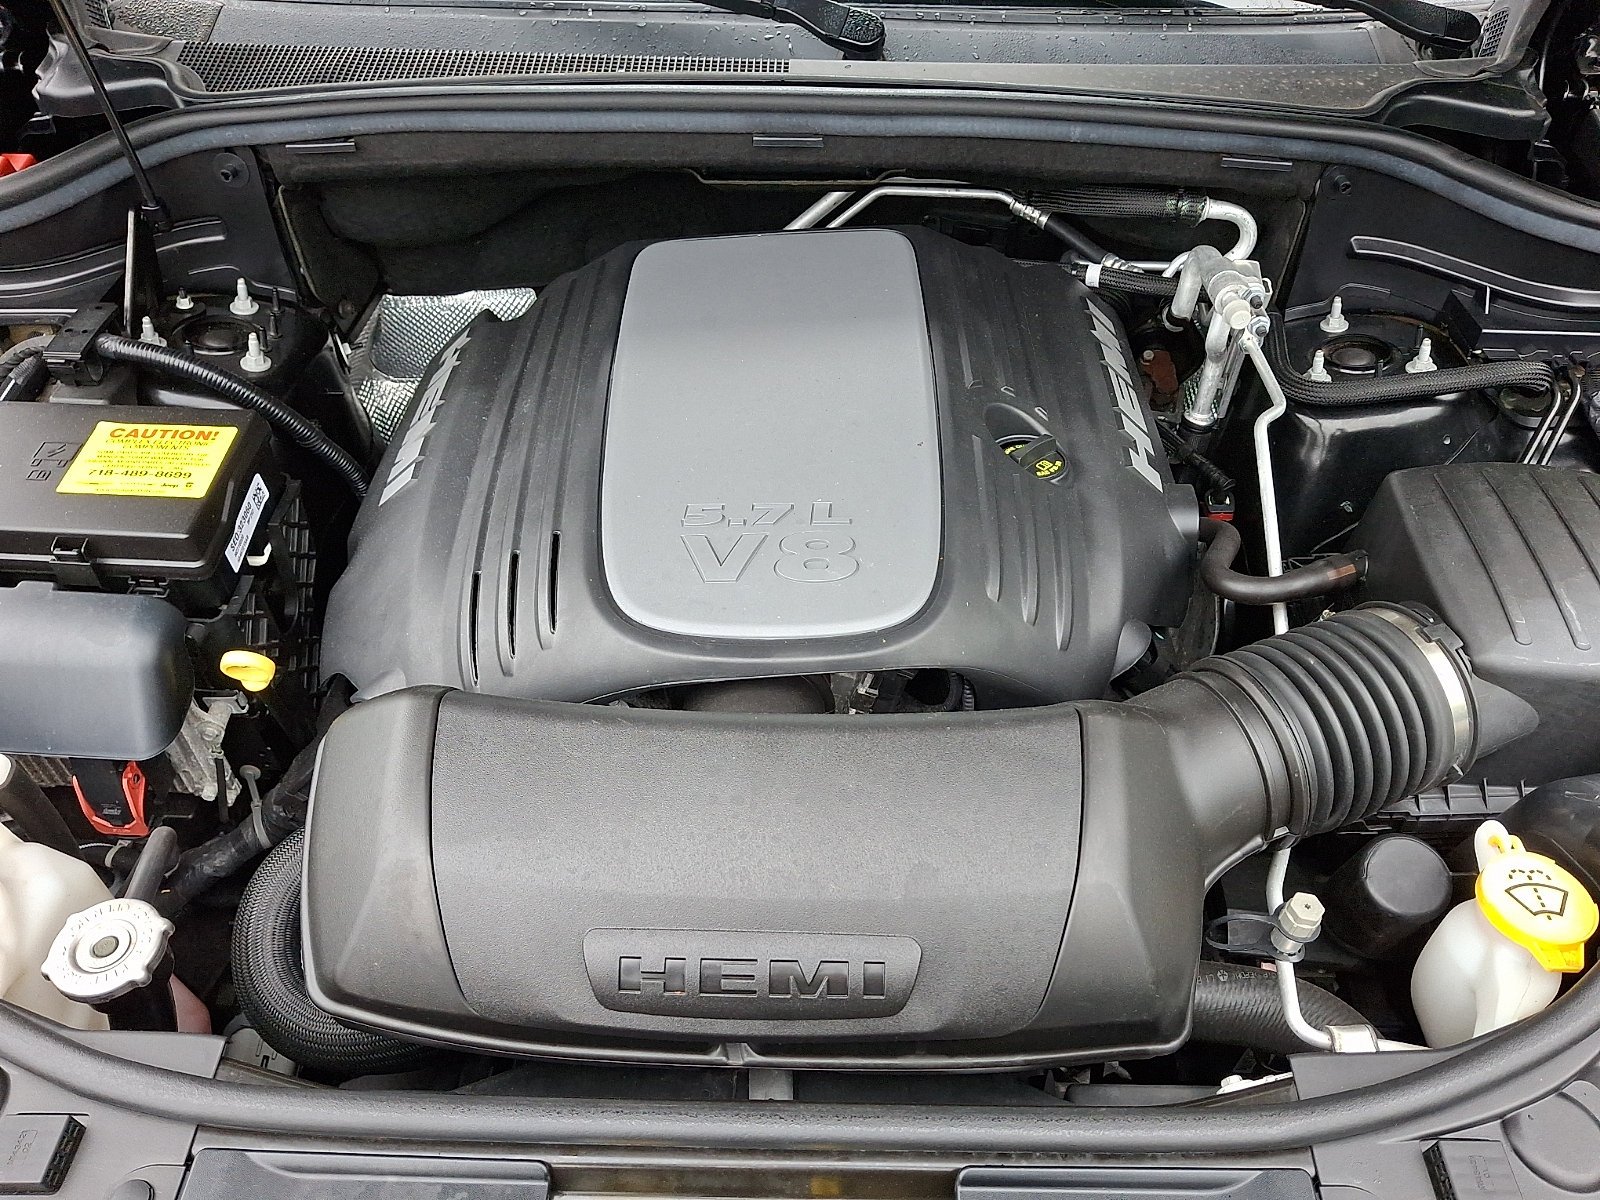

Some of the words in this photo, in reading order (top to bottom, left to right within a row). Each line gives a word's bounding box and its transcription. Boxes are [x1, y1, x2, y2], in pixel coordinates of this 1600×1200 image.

[1085, 297, 1164, 494] HEMI
[109, 428, 220, 441] CAUTION!
[679, 531, 860, 584] V8
[617, 955, 886, 999] HEMI
